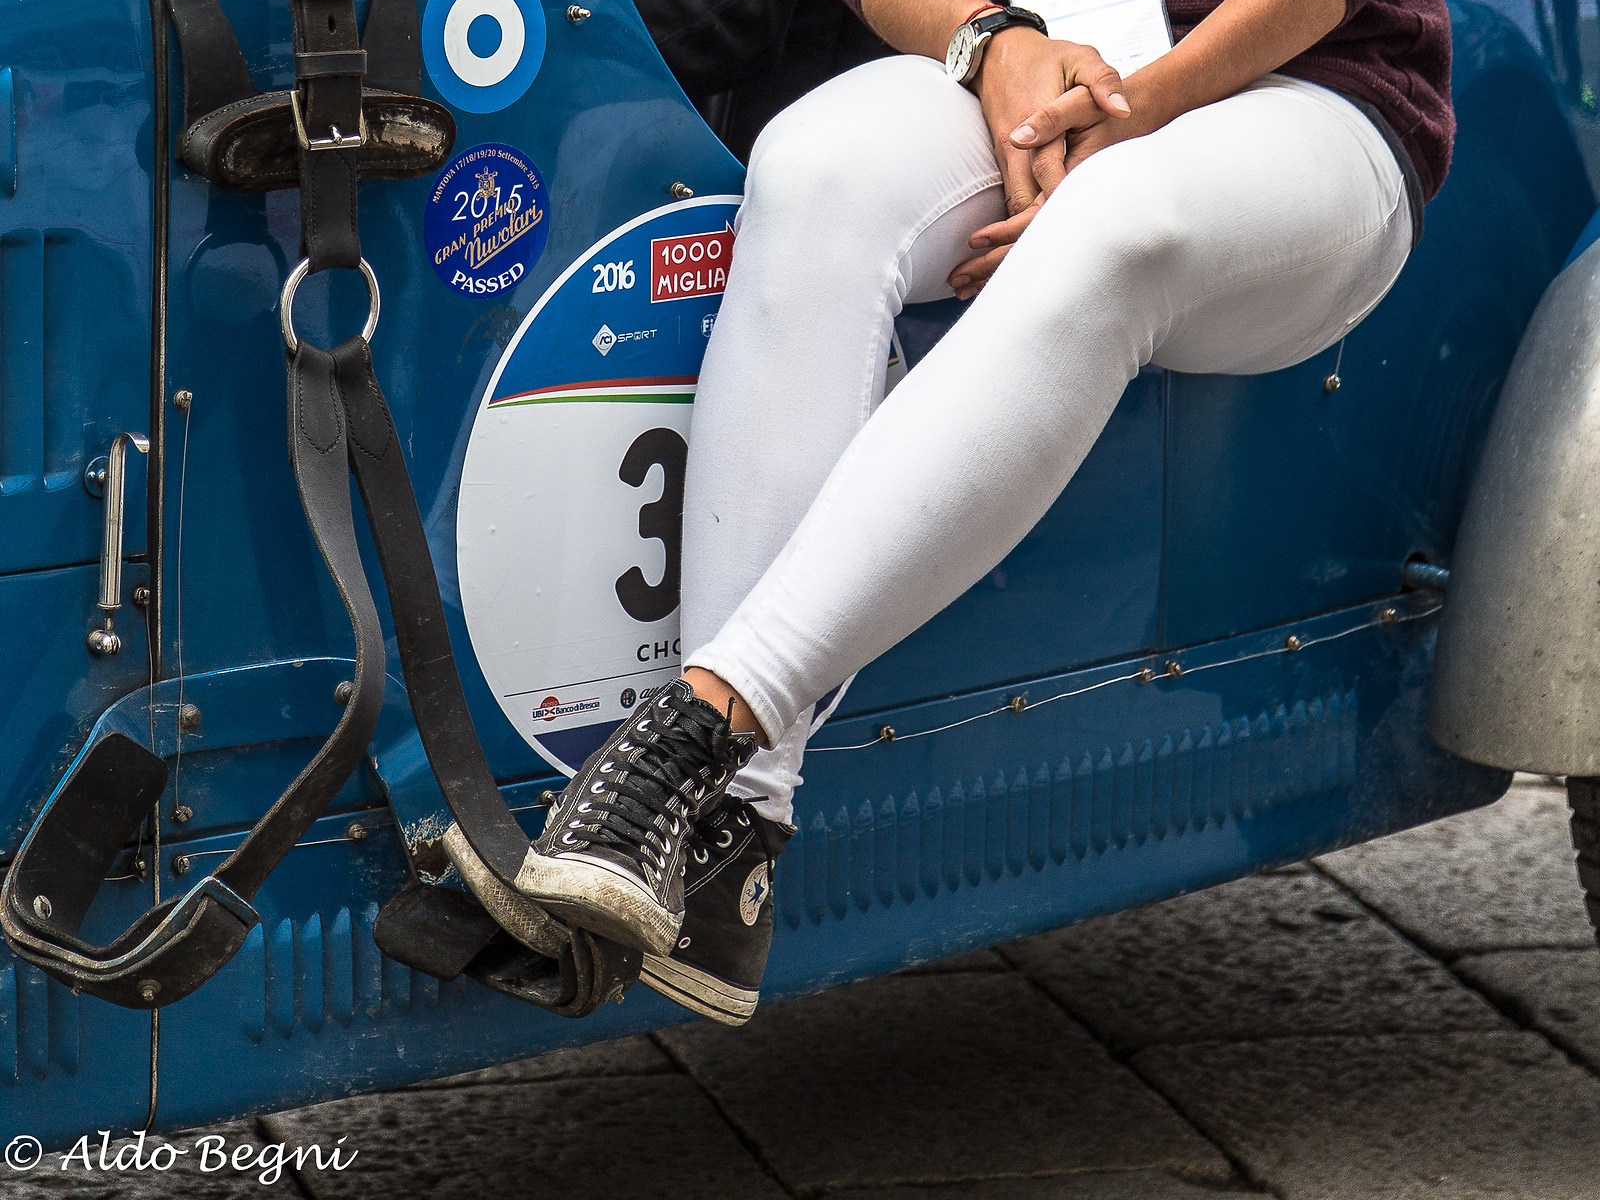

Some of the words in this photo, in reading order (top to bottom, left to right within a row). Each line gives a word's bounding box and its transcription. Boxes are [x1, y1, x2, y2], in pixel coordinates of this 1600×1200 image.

[432, 168, 456, 204] MANTOVA
[455, 149, 498, 171] 17/18/19/20
[497, 149, 529, 173] Settembre
[526, 170, 540, 190] 2015
[451, 184, 524, 221] 2015
[434, 232, 467, 265] GRAN
[473, 197, 516, 238] PREMIO
[464, 199, 544, 270] Nuvolari
[661, 239, 723, 266] 1000
[450, 262, 525, 294] PASSED
[591, 259, 636, 294] 2016
[656, 267, 727, 296] MIGLIA
[617, 329, 658, 343] SPORT
